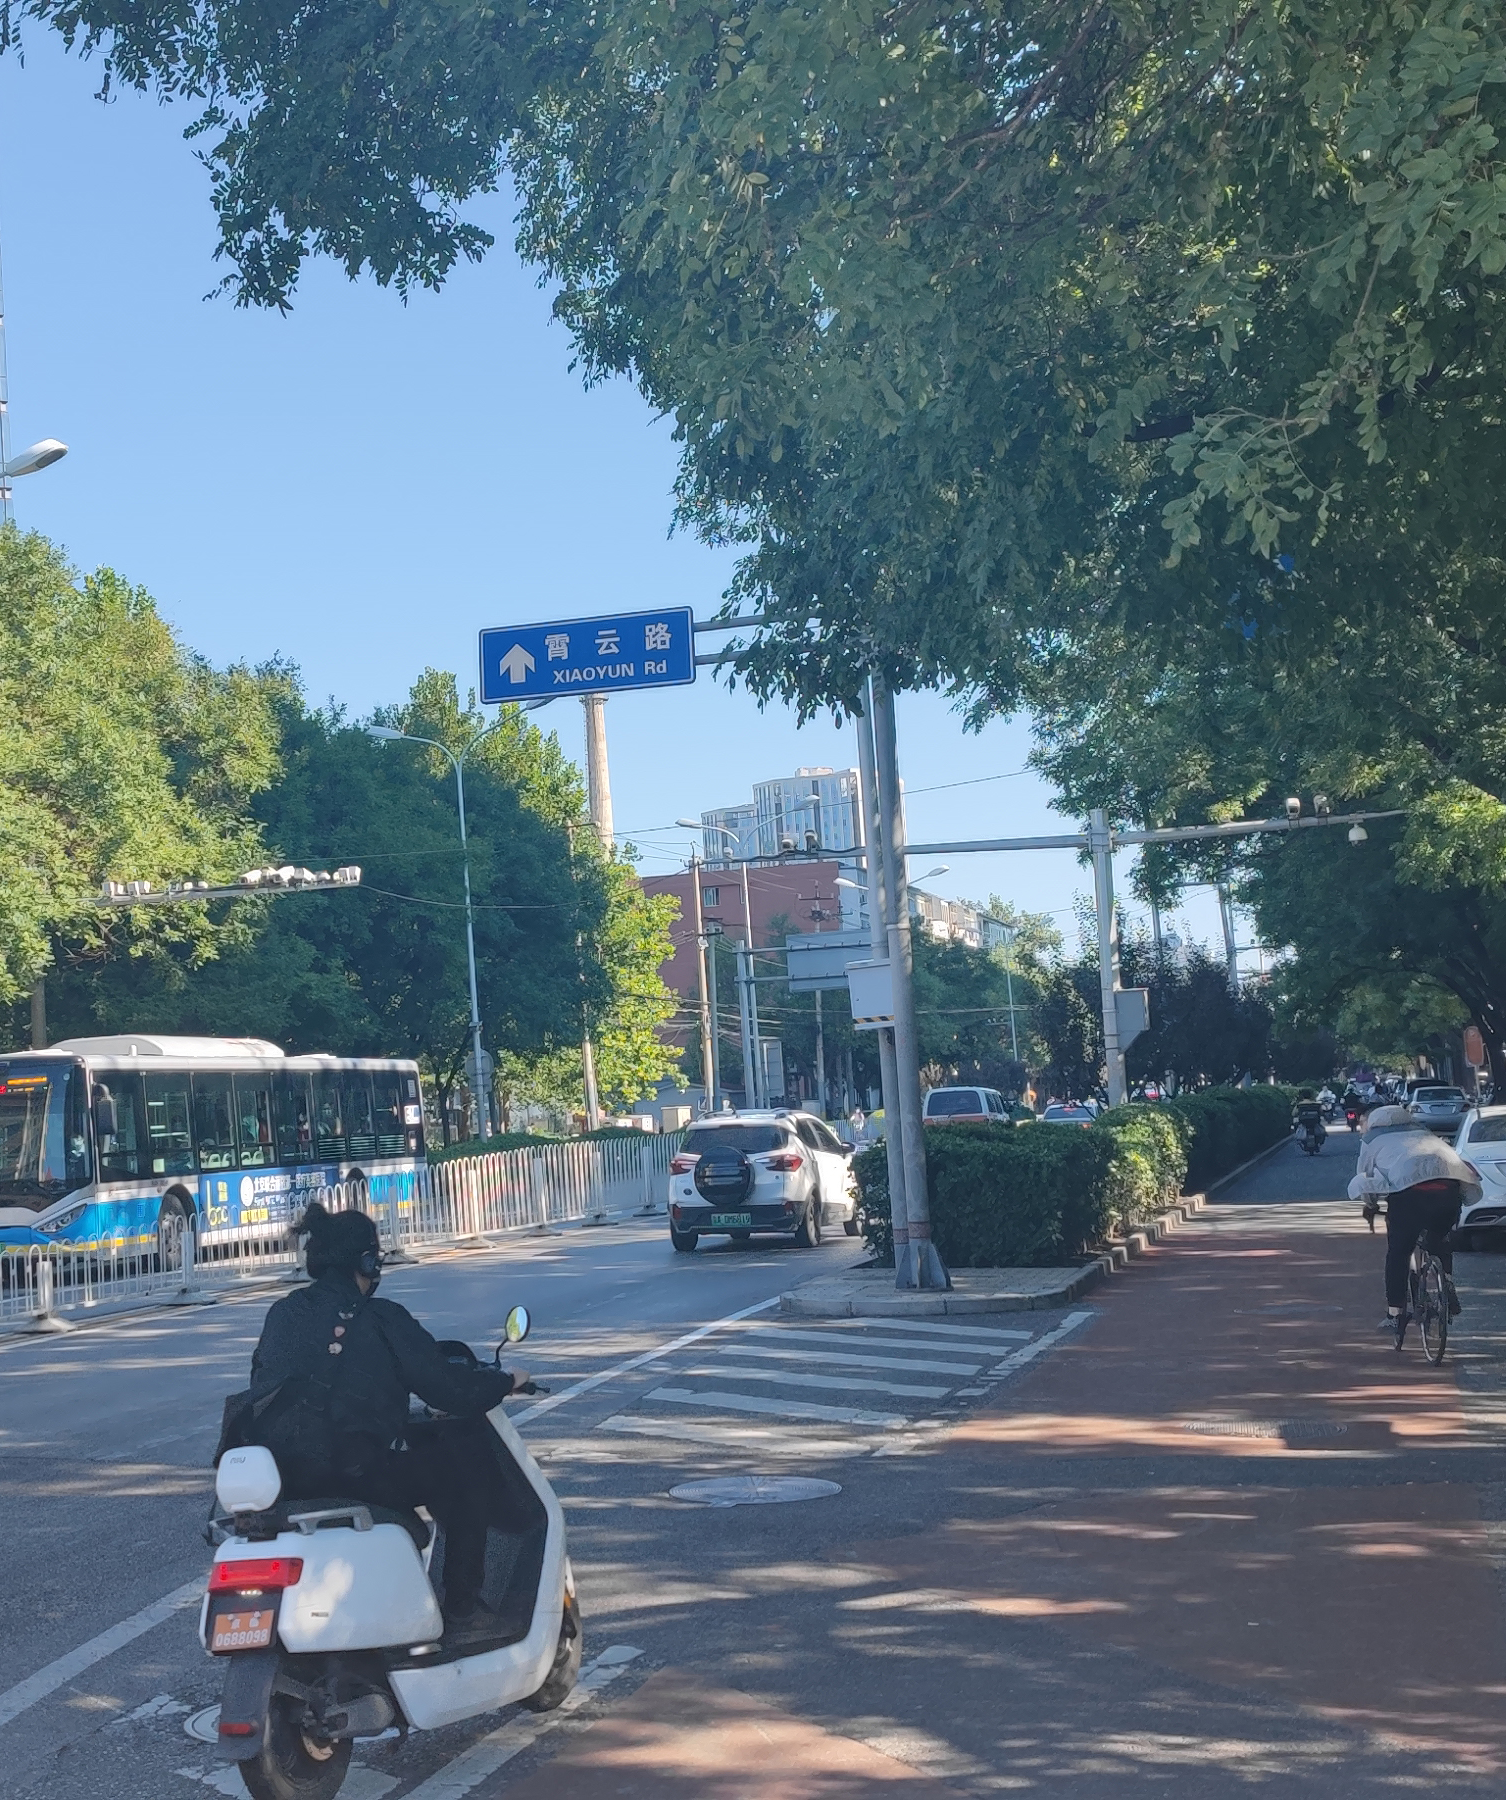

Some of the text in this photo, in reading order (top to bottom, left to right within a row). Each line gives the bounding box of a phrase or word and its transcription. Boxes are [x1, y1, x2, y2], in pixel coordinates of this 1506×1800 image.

[544, 622, 672, 661] 霄云路
[552, 659, 667, 685] XIAOYUN Rd
[215, 1628, 268, 1647] 0688098
